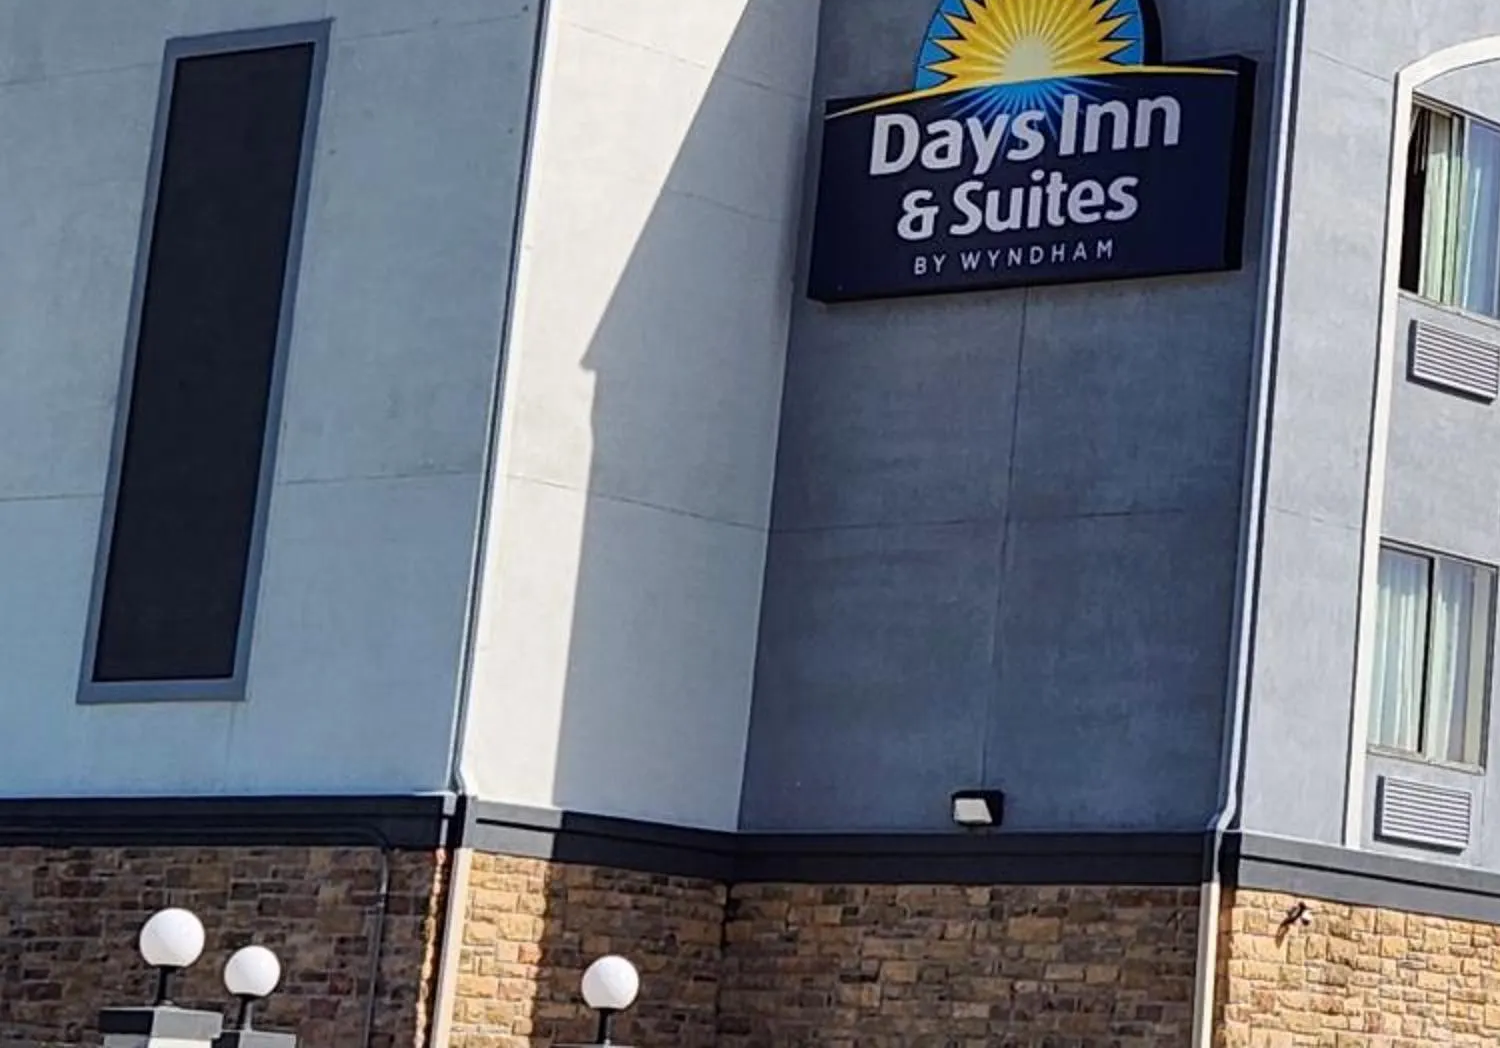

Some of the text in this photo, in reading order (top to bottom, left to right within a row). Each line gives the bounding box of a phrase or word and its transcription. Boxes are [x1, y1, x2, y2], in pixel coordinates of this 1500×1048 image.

[869, 94, 1182, 175] Days Inn
[897, 169, 1139, 240] & Suites
[913, 239, 1114, 275] BY WYNDHAM
